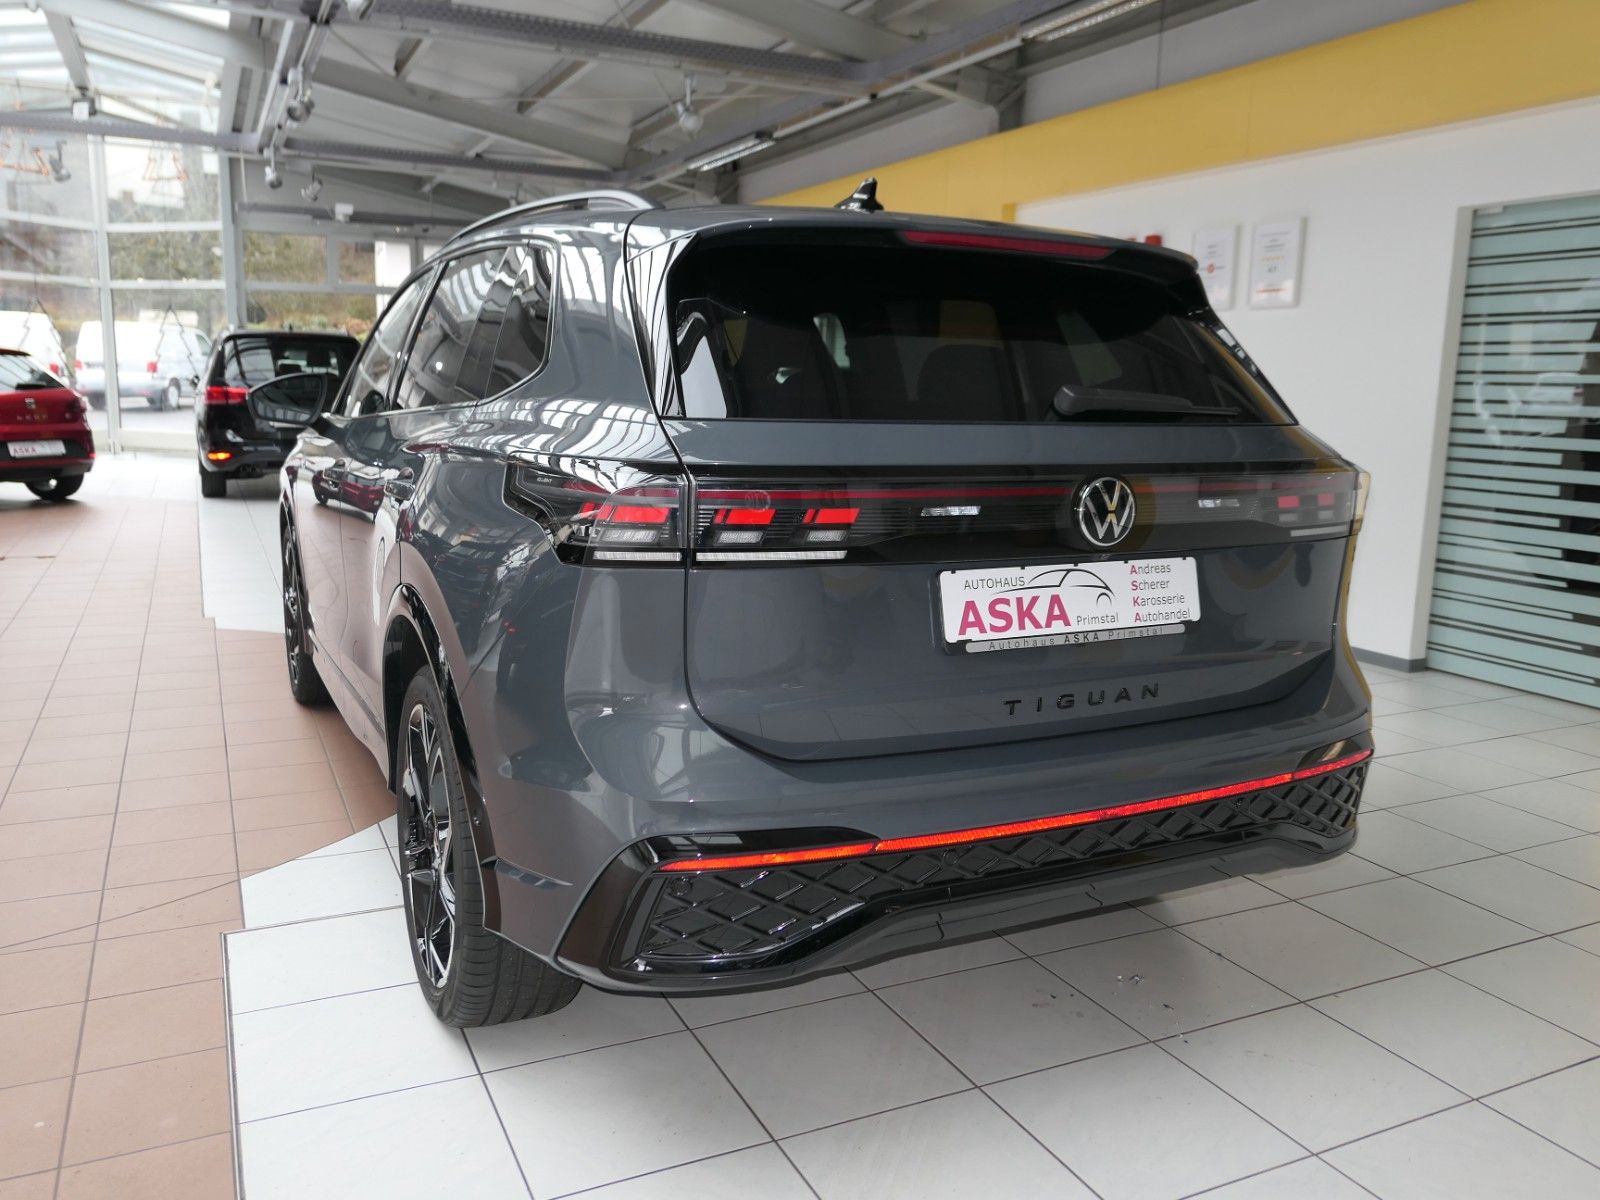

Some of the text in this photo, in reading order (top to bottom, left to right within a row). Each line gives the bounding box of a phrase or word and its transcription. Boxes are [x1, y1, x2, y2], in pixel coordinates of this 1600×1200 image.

[1130, 563, 1171, 575] Andreas
[964, 576, 1026, 591] AUTOHAUS
[1131, 579, 1170, 591] Scherer
[1132, 593, 1185, 607] Karosserie
[958, 594, 1119, 636] ASKA Primstal
[1134, 608, 1191, 623] Autohandel
[988, 628, 1163, 651] Autohaus ASKA Primstal
[1003, 683, 1159, 716] TIGUAN
